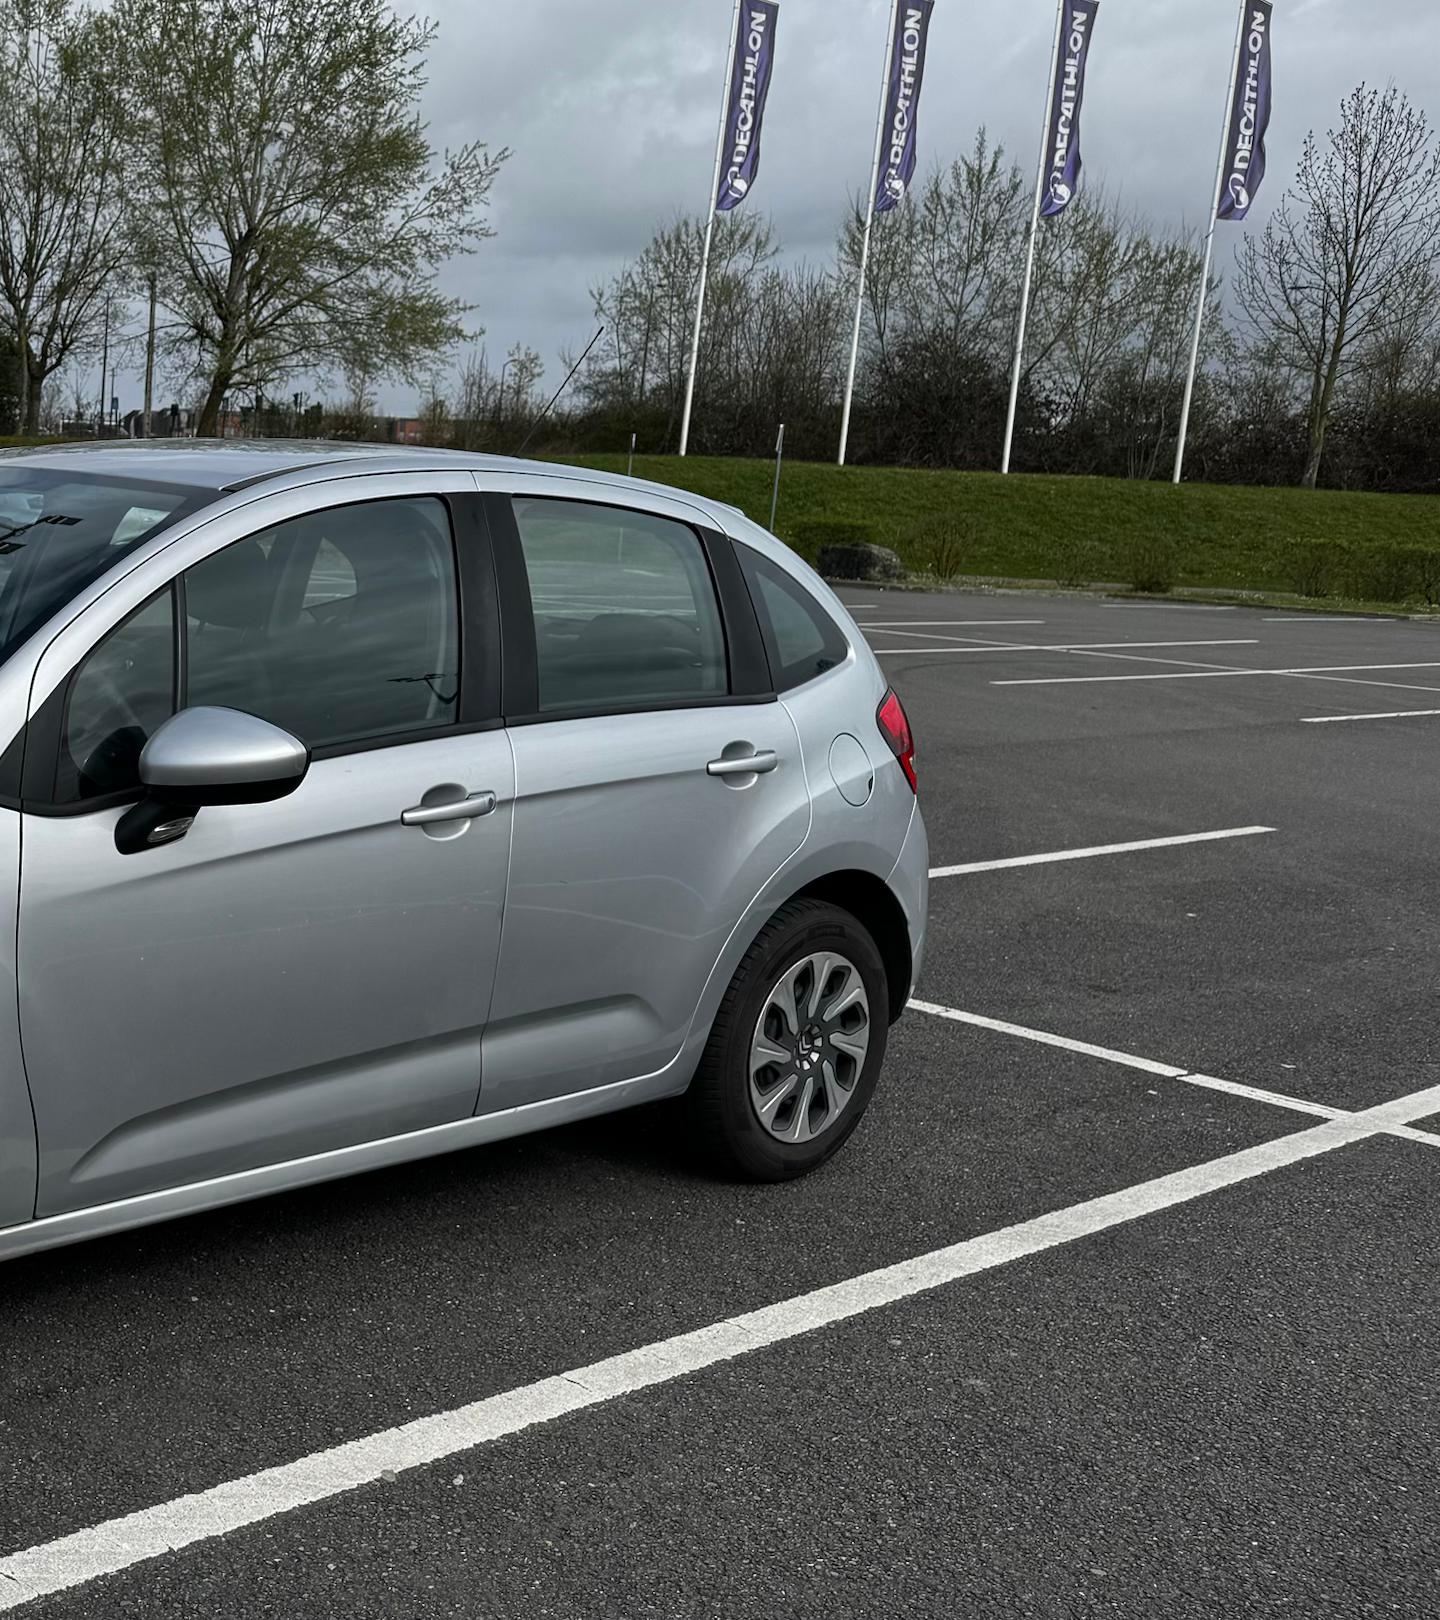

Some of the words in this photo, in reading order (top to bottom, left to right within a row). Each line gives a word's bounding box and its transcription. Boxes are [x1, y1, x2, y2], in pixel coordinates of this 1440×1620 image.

[732, 11, 767, 164] DECATHLON
[889, 8, 922, 165] DECATHLON
[1053, 10, 1088, 169] DECATHLON
[1233, 10, 1266, 170] DECATHLON
